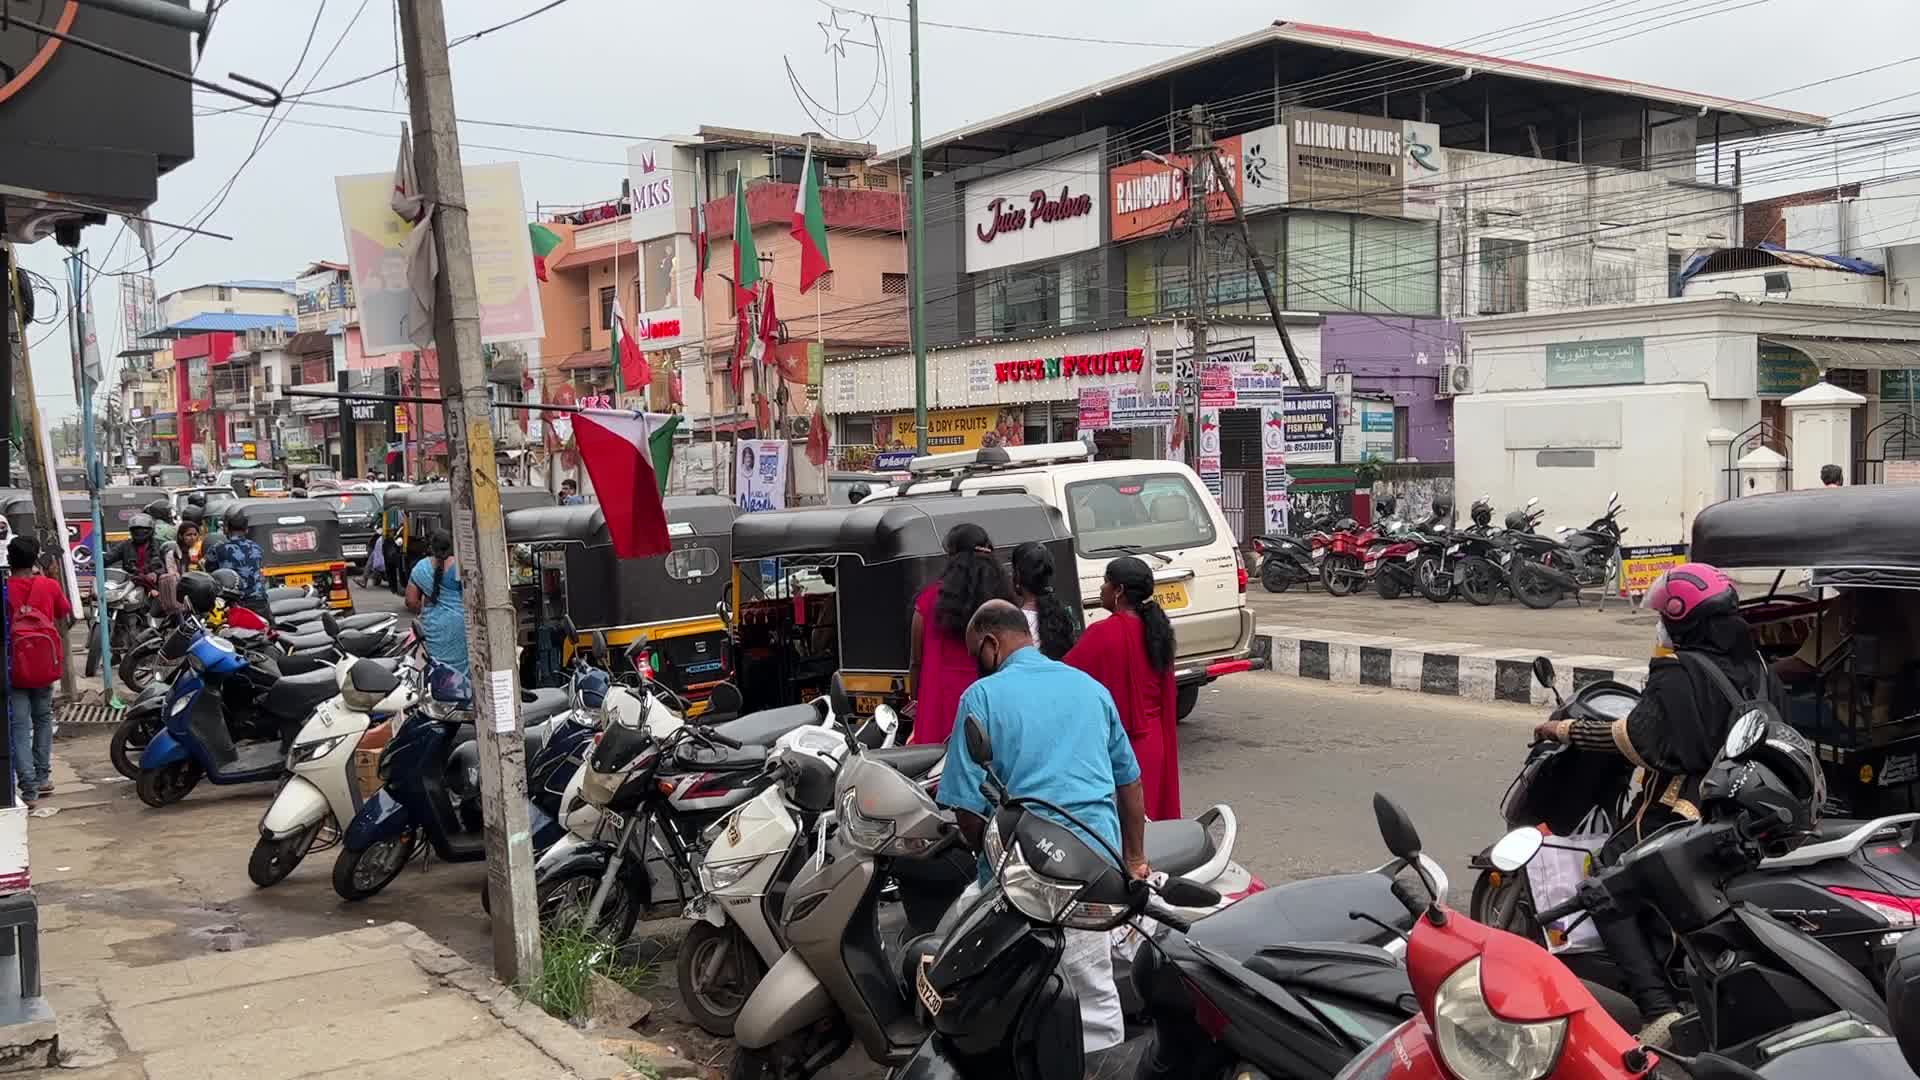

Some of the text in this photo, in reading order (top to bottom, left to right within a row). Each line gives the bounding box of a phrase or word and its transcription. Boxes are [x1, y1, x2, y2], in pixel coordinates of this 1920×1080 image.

[1295, 119, 1400, 156] RAINBOW GRAPHICS
[632, 178, 671, 211] MKS
[1116, 171, 1170, 215] RAINBOW
[977, 185, 1092, 243] Juice Parlour
[995, 359, 1045, 384] NUTZ
[1045, 357, 1060, 380] N
[1063, 348, 1144, 378] FRUITZ
[352, 405, 375, 419] HUNT
[935, 419, 953, 432] DRY
[954, 417, 987, 431] FRUITS
[1036, 838, 1066, 863] M.S
